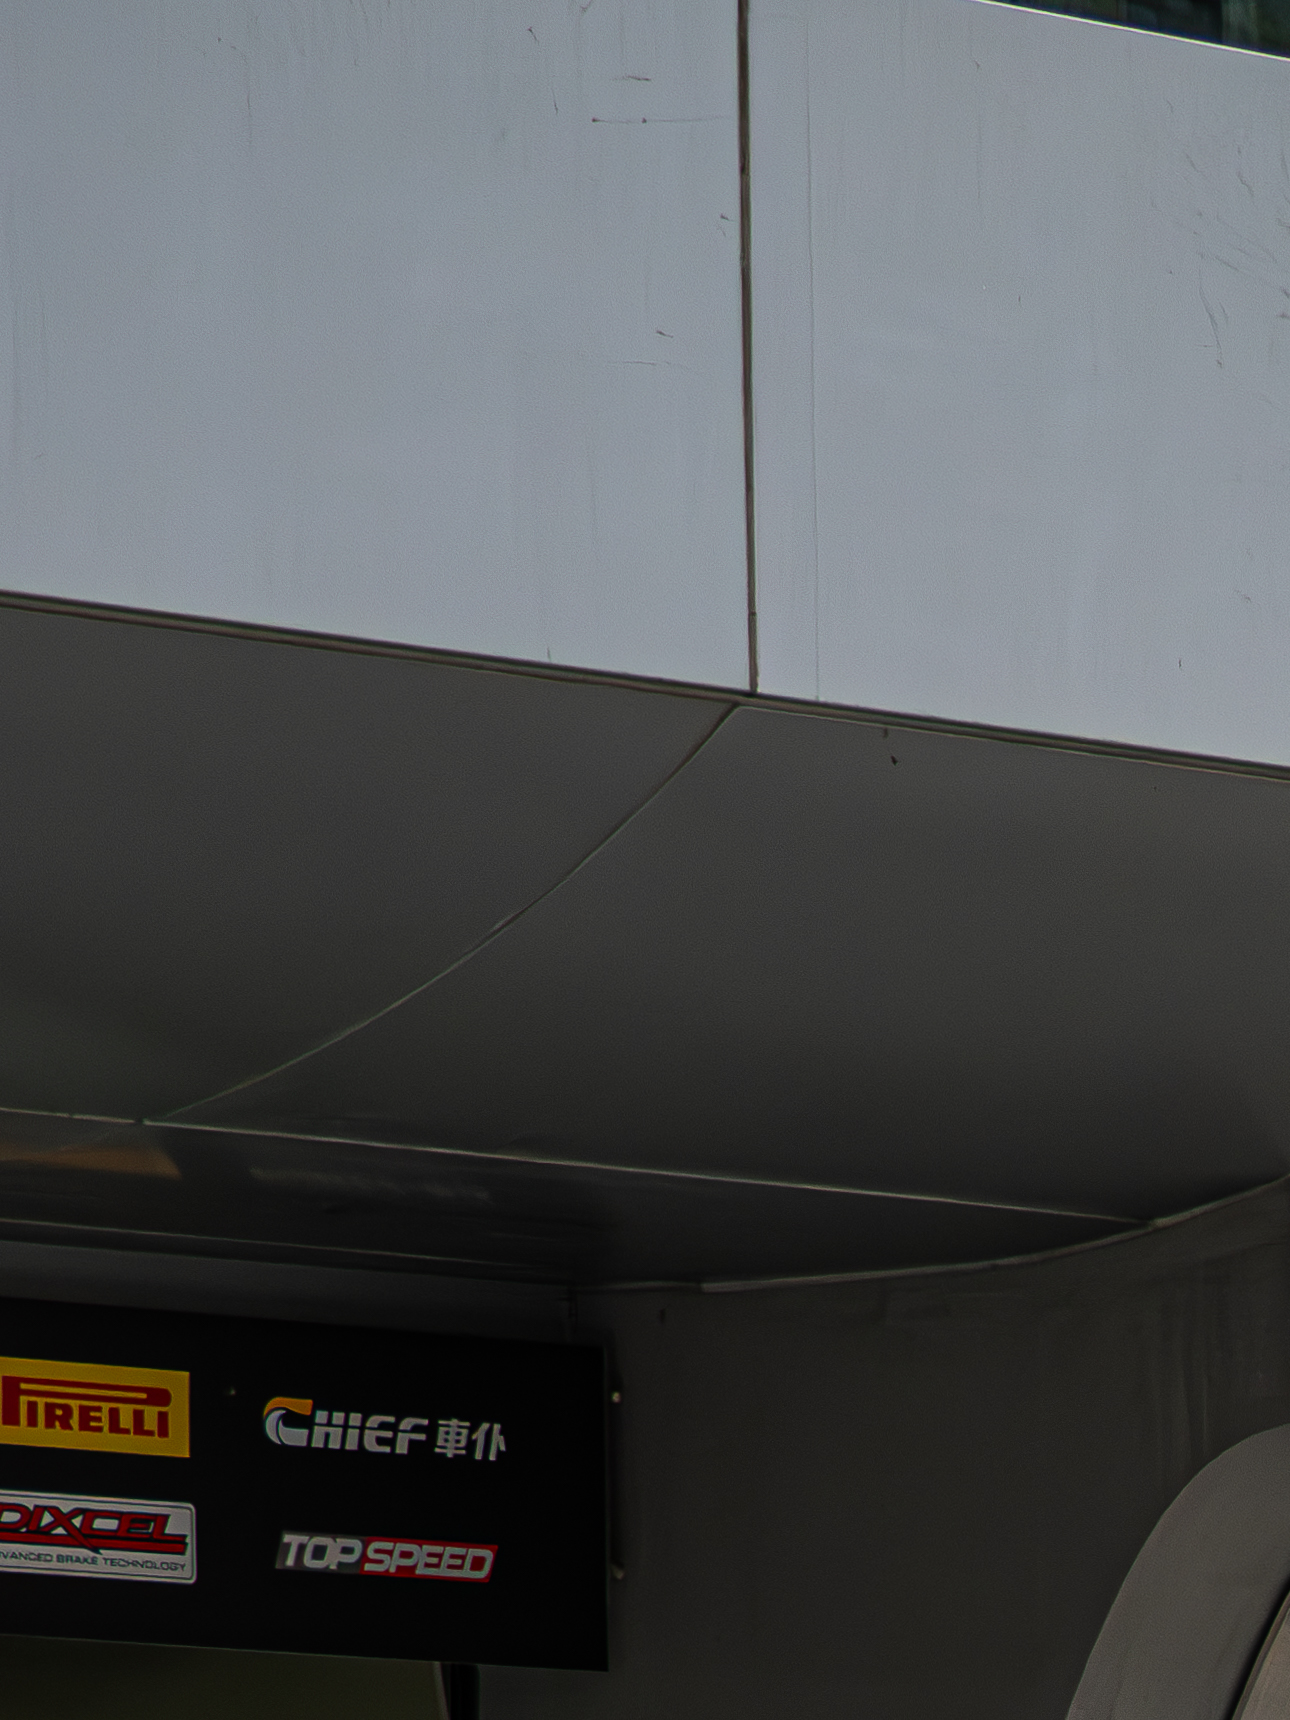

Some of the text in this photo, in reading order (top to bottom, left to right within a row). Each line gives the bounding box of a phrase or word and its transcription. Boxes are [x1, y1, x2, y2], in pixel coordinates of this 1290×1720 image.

[1, 1375, 172, 1439] PIRELLI
[263, 1396, 429, 1454] CHIEF
[0, 1503, 188, 1554] DIXCEL
[56, 1554, 99, 1566] BRAKE
[103, 1557, 187, 1573] TECHNOLOGY
